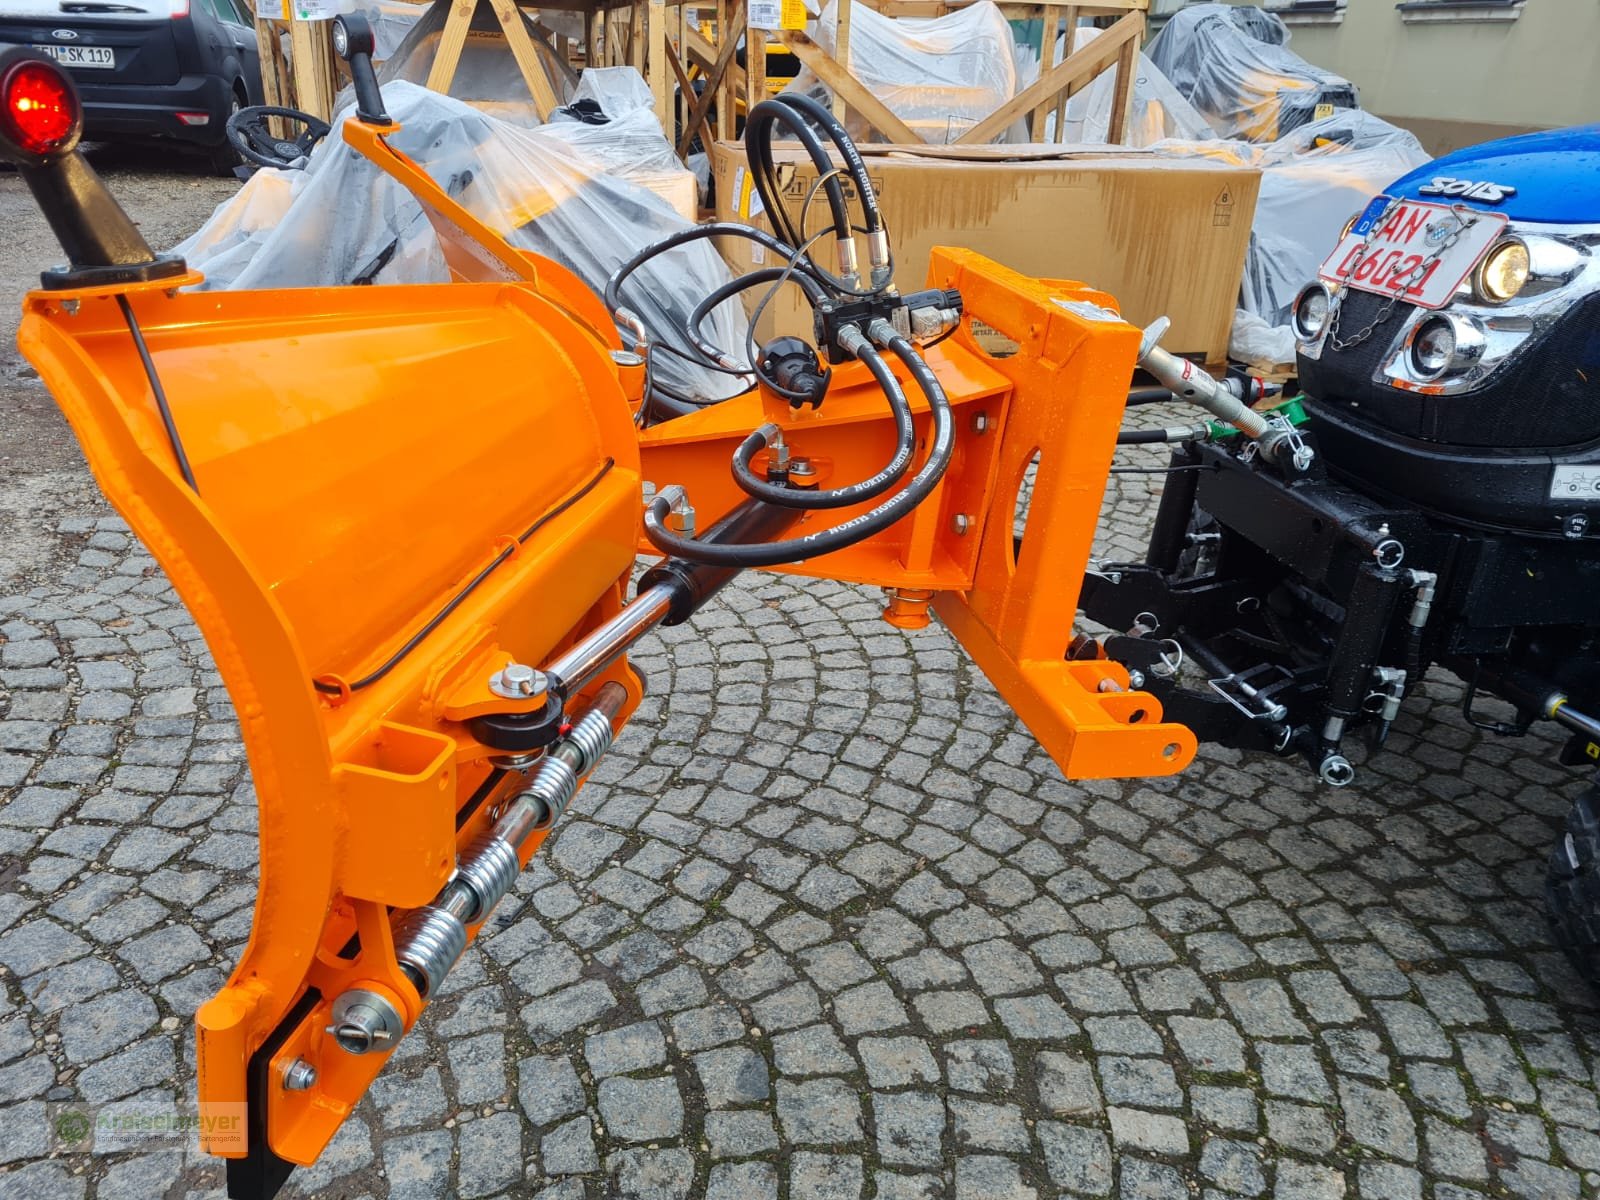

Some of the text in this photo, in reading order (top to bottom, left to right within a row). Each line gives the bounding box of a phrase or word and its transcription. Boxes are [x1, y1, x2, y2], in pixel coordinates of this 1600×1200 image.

[68, 47, 85, 62] SK
[88, 48, 112, 63] 119
[841, 136, 878, 210] NORTH FIGHTER
[1359, 221, 1368, 232] D
[1375, 206, 1432, 244] AN
[1335, 243, 1441, 297] 06021
[855, 472, 888, 492] NORTH
[887, 445, 910, 474] FIGHTER
[828, 488, 910, 535] NORTH FIGHTER
